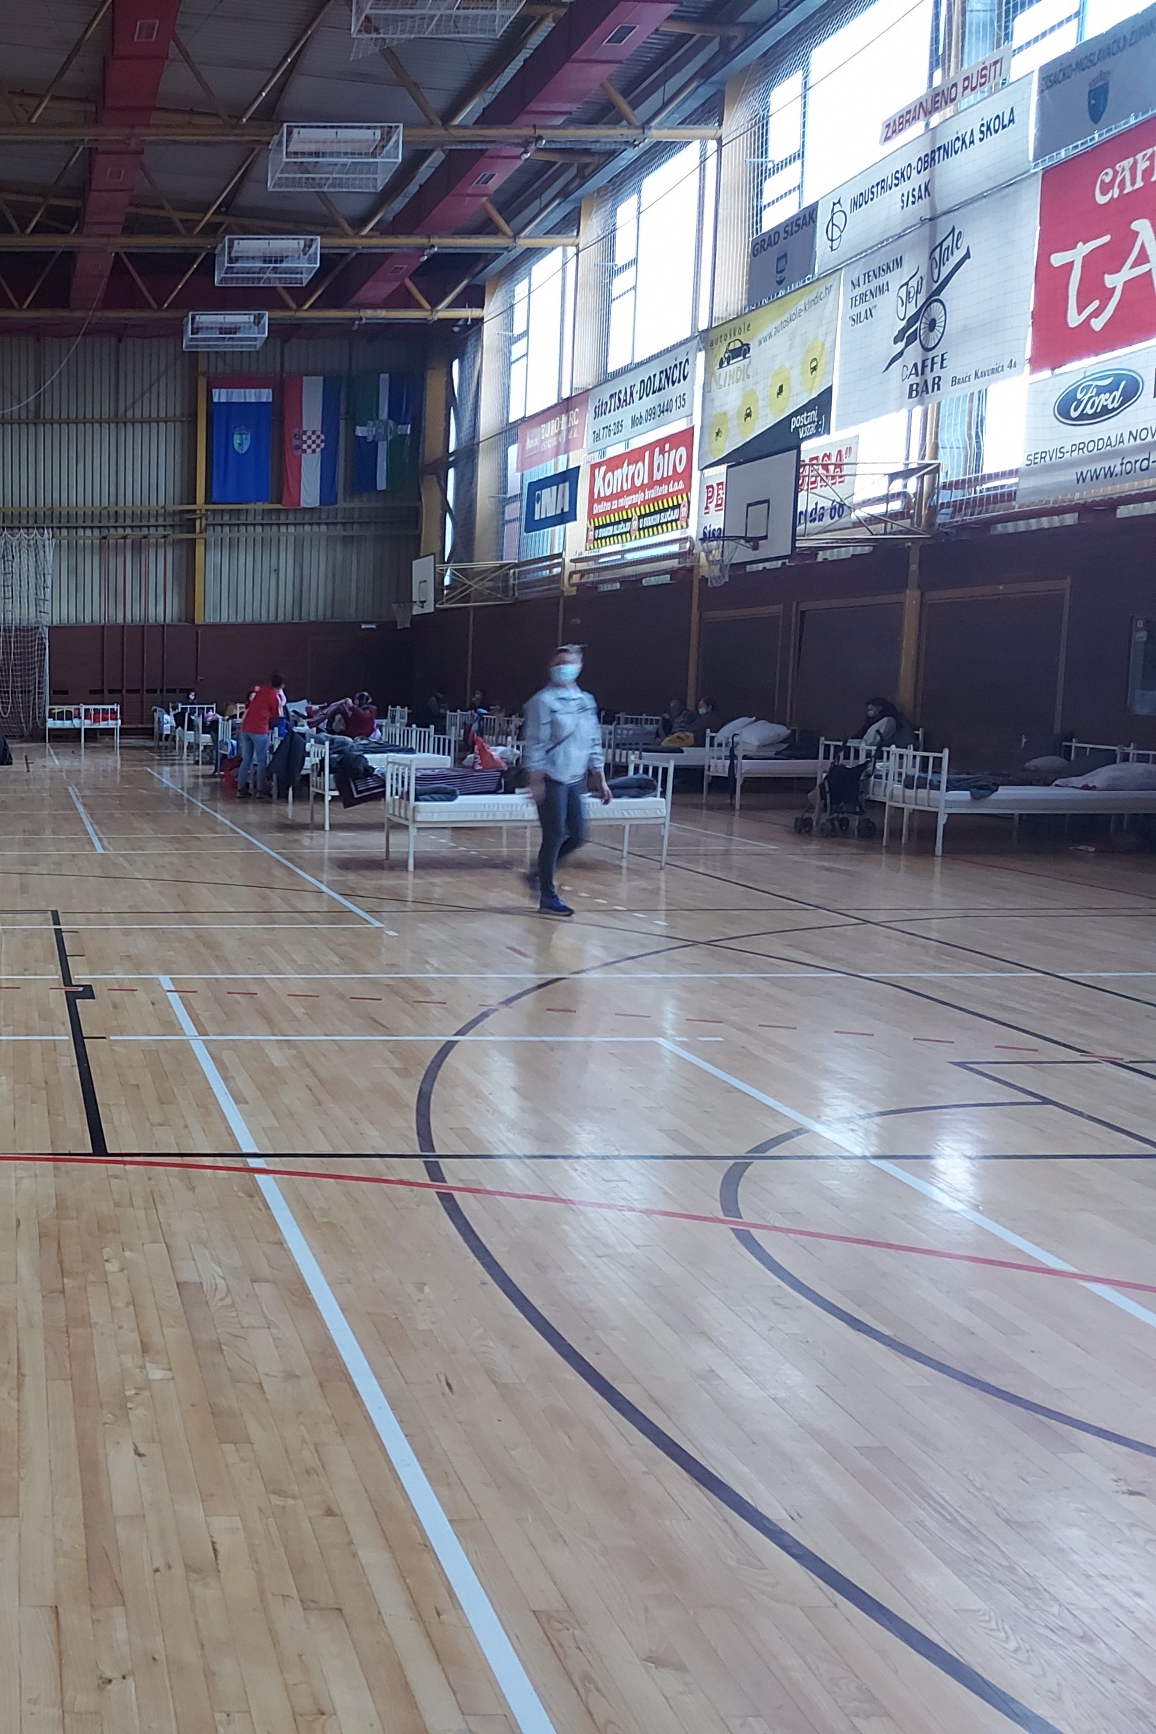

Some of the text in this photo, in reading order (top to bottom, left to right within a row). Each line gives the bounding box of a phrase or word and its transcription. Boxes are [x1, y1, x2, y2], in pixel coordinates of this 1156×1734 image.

[883, 57, 1004, 142] ZABRANJENO PUŠITI
[849, 106, 1015, 214] INDUSTRIJSKO-OBRTNIČKA ŠKOLA
[1095, 146, 1156, 204] CAF
[900, 179, 931, 210] SISAK
[752, 230, 780, 257] GRAD
[783, 209, 816, 240] SISAK
[850, 255, 903, 292] NA TENISKIM
[850, 281, 890, 310] TERENIMA
[907, 375, 942, 400] BAR
[1069, 376, 1126, 419] Ford
[790, 406, 818, 432] postani
[1025, 432, 1125, 467] SERVIS-PRODAJA
[593, 443, 687, 499] Kontrol biro
[704, 481, 724, 515] PE
